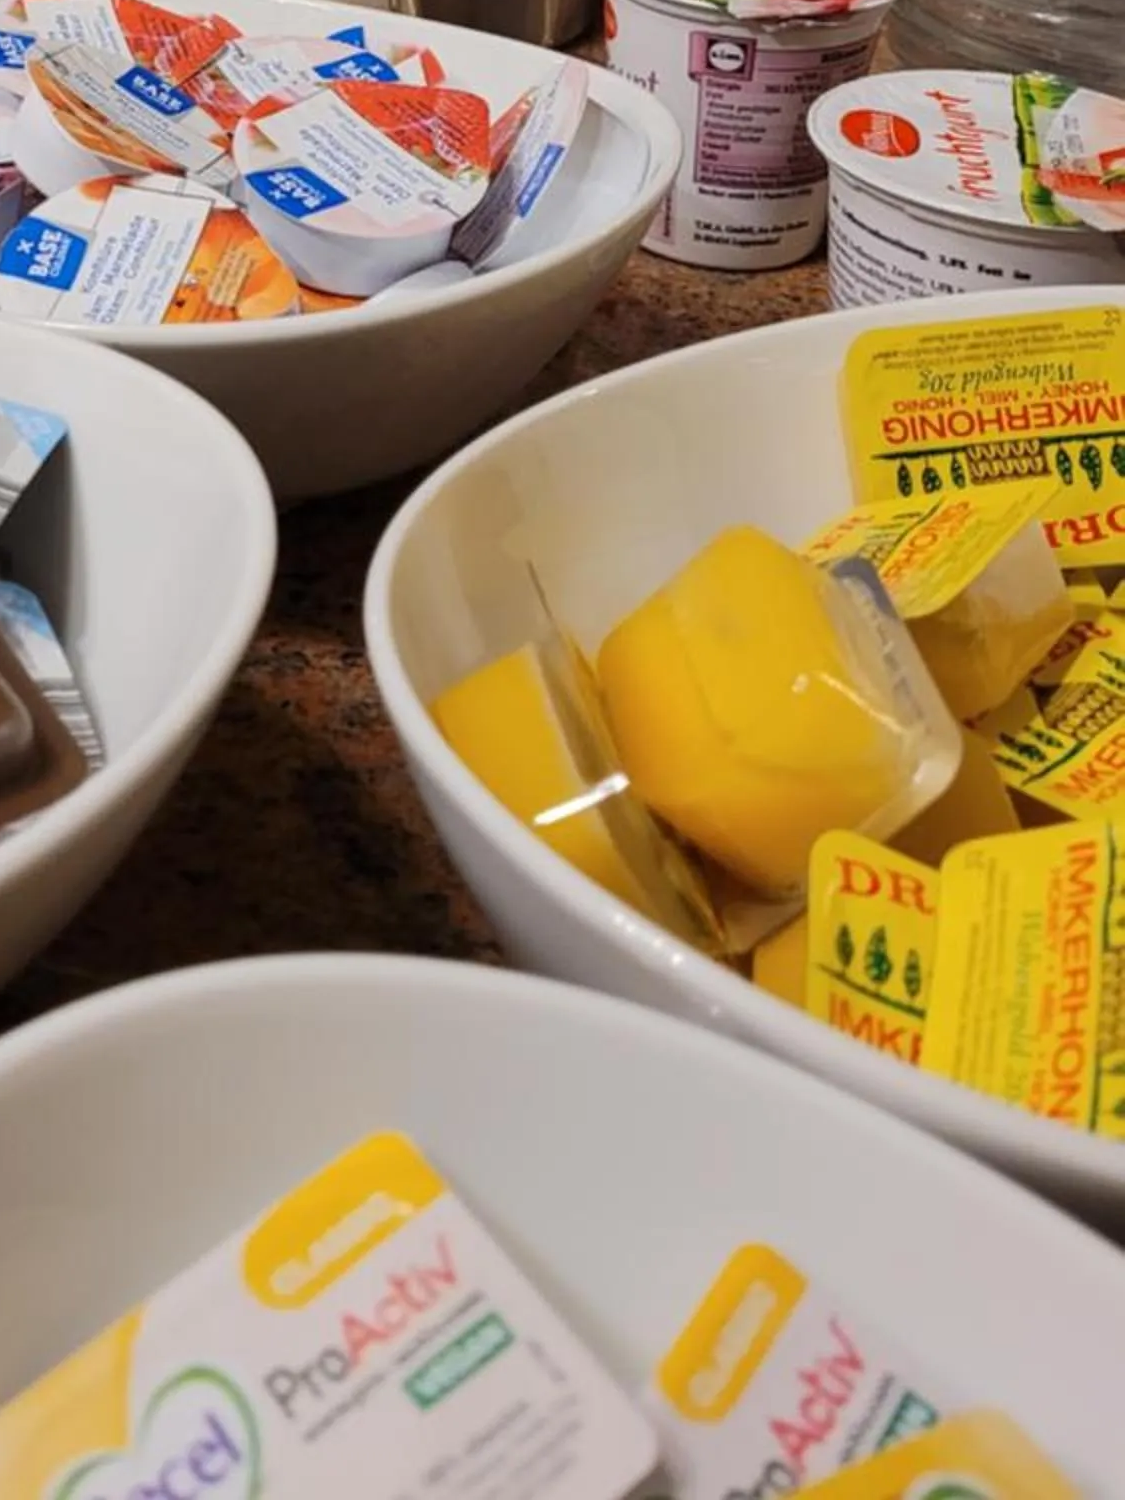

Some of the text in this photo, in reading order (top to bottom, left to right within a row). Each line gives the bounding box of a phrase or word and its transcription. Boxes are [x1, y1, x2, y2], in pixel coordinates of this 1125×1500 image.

[27, 228, 61, 277] BASE
[892, 379, 1110, 413] HONEY MIEL HONIG
[263, 1232, 460, 1417] ProActiv
